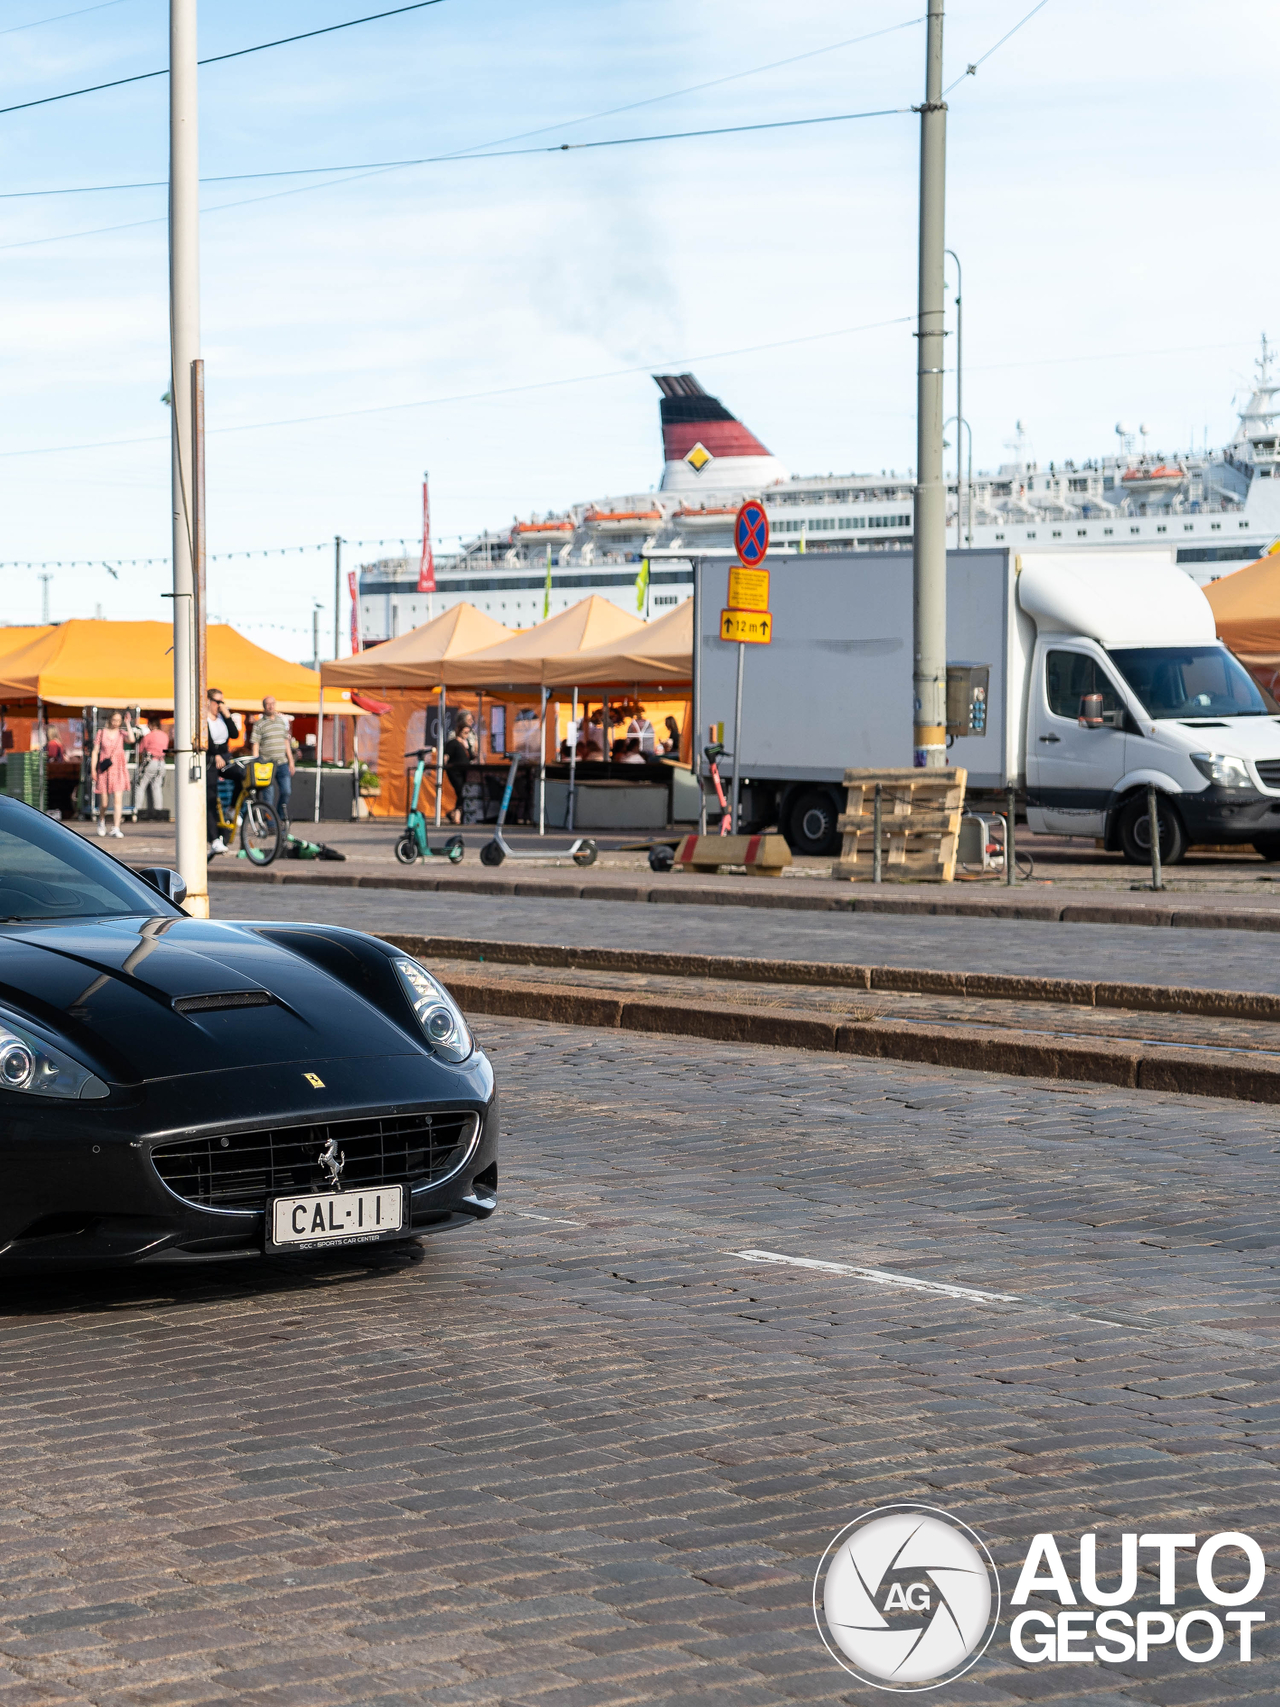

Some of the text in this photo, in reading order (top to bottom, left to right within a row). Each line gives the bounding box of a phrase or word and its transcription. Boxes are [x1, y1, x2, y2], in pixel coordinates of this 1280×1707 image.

[736, 620, 758, 633] 12 m
[292, 1195, 381, 1234] CAL-11
